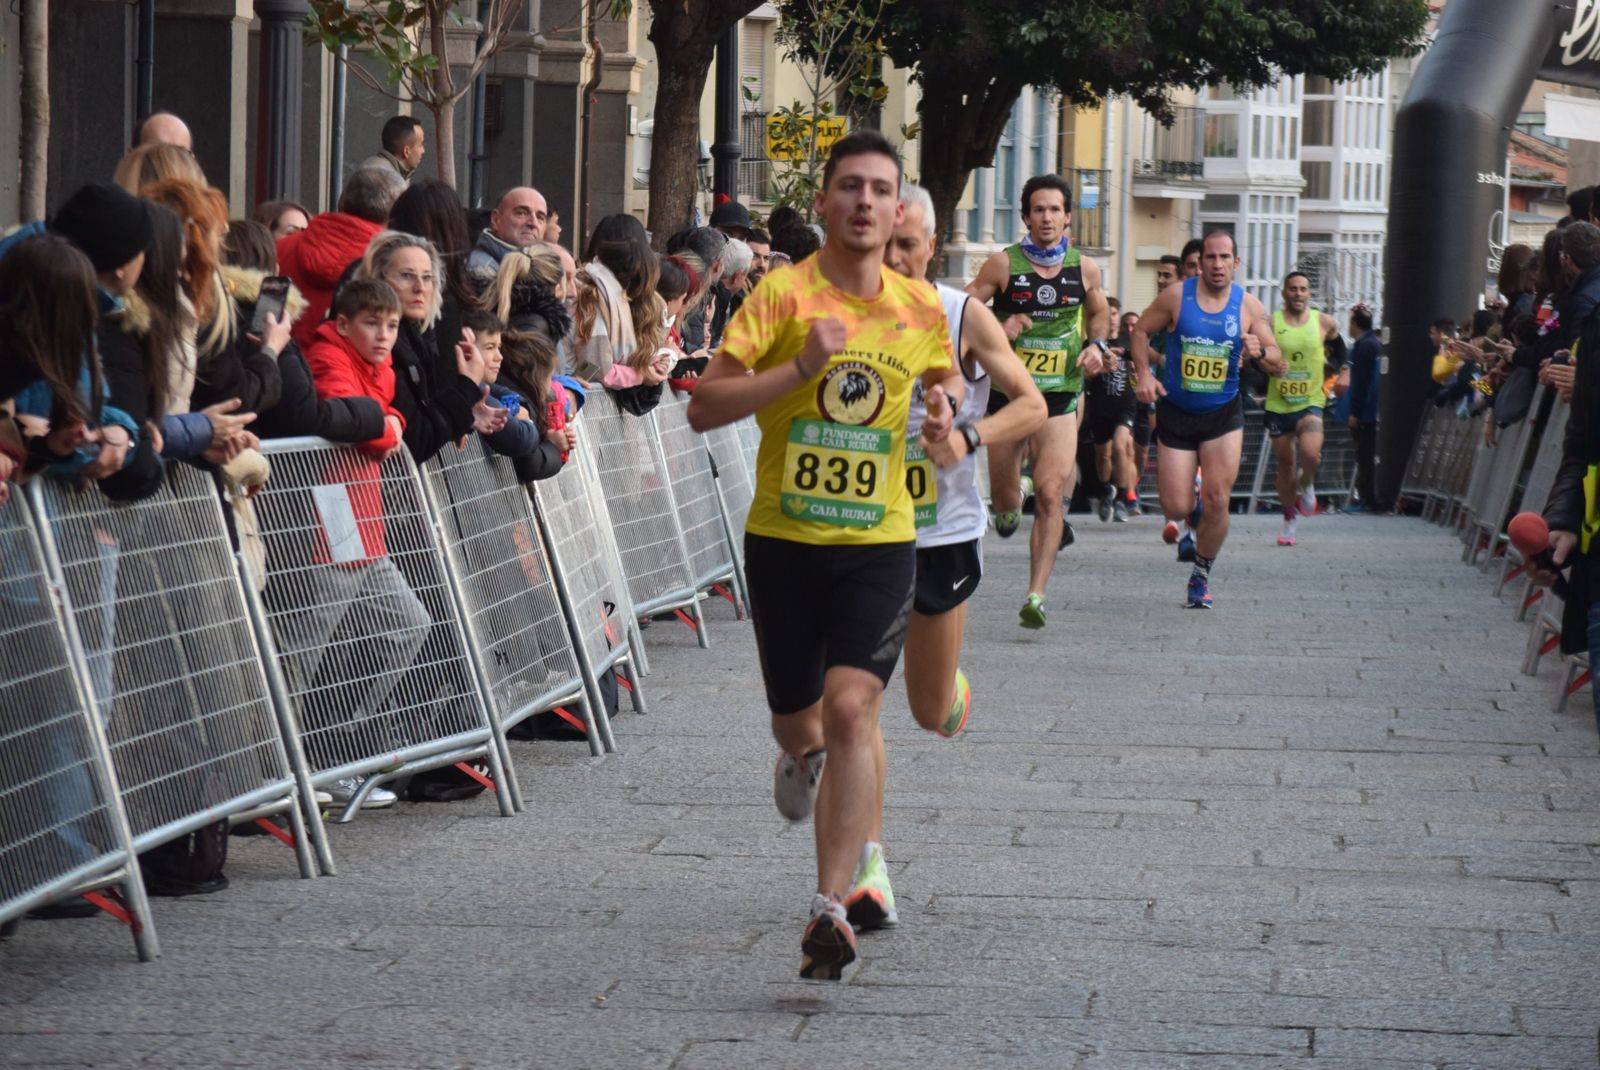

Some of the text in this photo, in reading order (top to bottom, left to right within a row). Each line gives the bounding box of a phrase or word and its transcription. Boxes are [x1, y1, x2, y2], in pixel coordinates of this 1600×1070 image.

[1022, 351, 1058, 374] 721
[1184, 358, 1223, 380] 605
[1279, 381, 1308, 395] 660
[821, 427, 880, 443] FUNDACION
[821, 438, 846, 449] CAJA
[847, 440, 879, 452] RURAL
[794, 452, 877, 498] 839
[809, 503, 879, 522] CAJA RURAL
